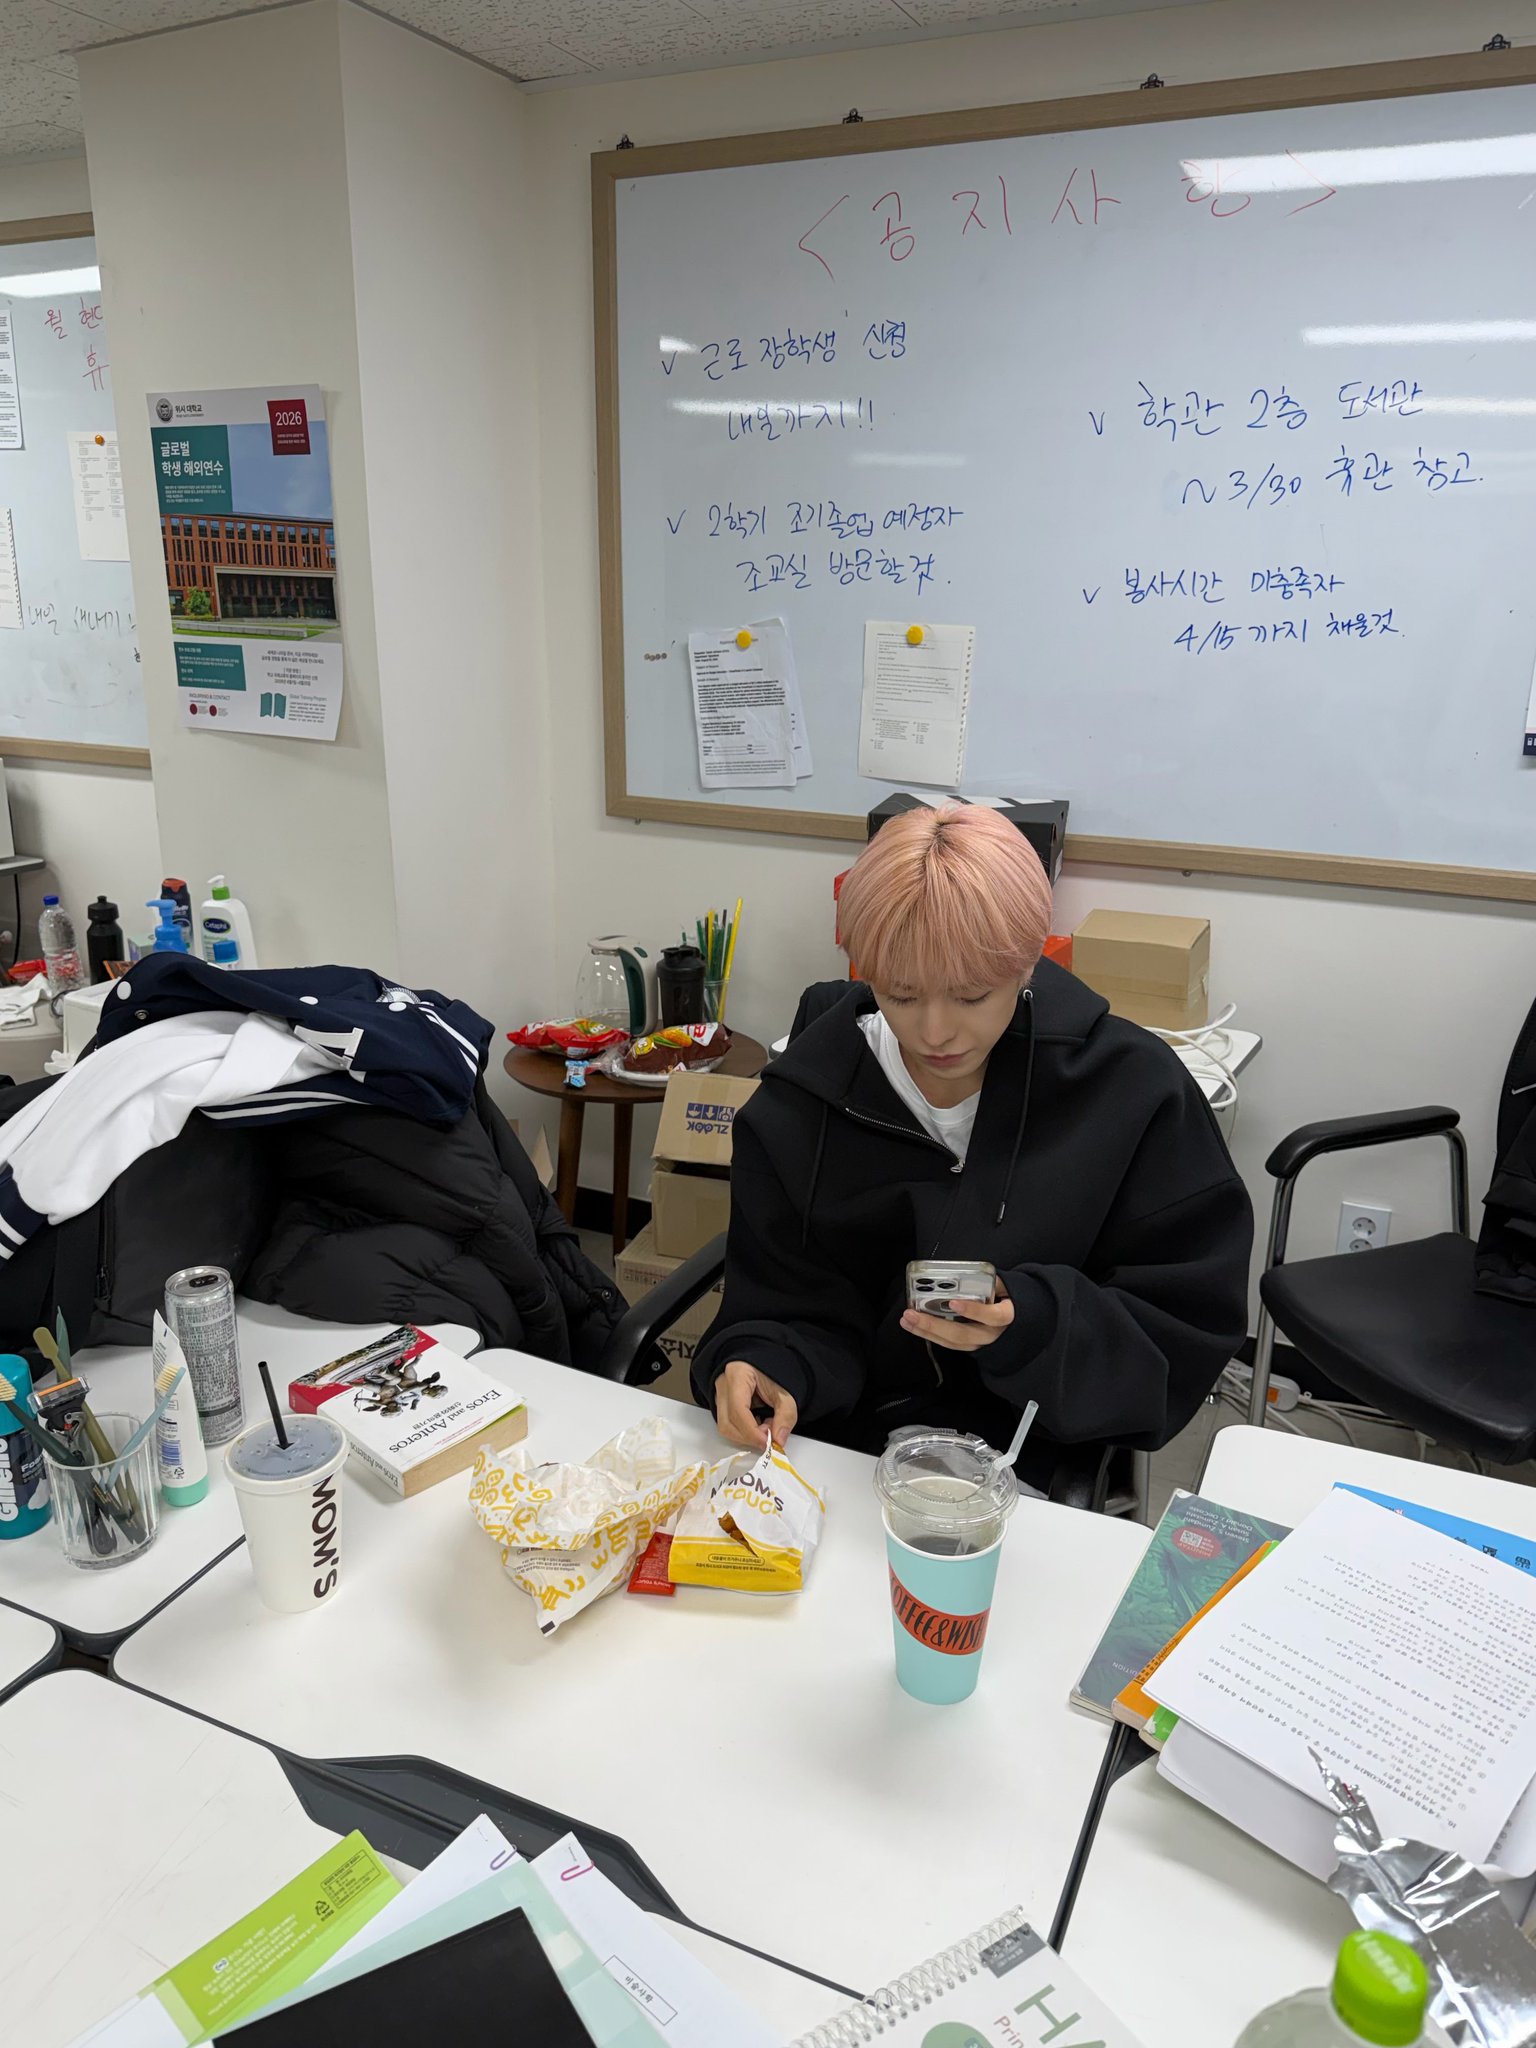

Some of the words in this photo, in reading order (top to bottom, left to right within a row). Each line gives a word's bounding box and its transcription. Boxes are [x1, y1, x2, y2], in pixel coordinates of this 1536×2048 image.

[701, 338, 749, 381] 근로
[760, 328, 836, 371] 장학생
[276, 411, 302, 426] 2026
[1137, 381, 1225, 442] 학관
[1247, 386, 1308, 430] 2층
[1338, 380, 1424, 419] 도서관
[160, 440, 190, 457] 글로벌
[161, 461, 181, 477] 학생
[184, 460, 224, 477] 해외연수
[1325, 445, 1394, 497] 휴관
[709, 502, 766, 540] 2학기
[736, 553, 812, 592] 조교실
[1125, 568, 1226, 604] 봉사시간
[1251, 566, 1346, 600] 미충족자
[204, 921, 228, 931] Cetaphil
[448, 1408, 465, 1421] and
[466, 1389, 502, 1411] Eros
[389, 1418, 448, 1454] Anteros
[312, 1474, 338, 1599] MOM'S
